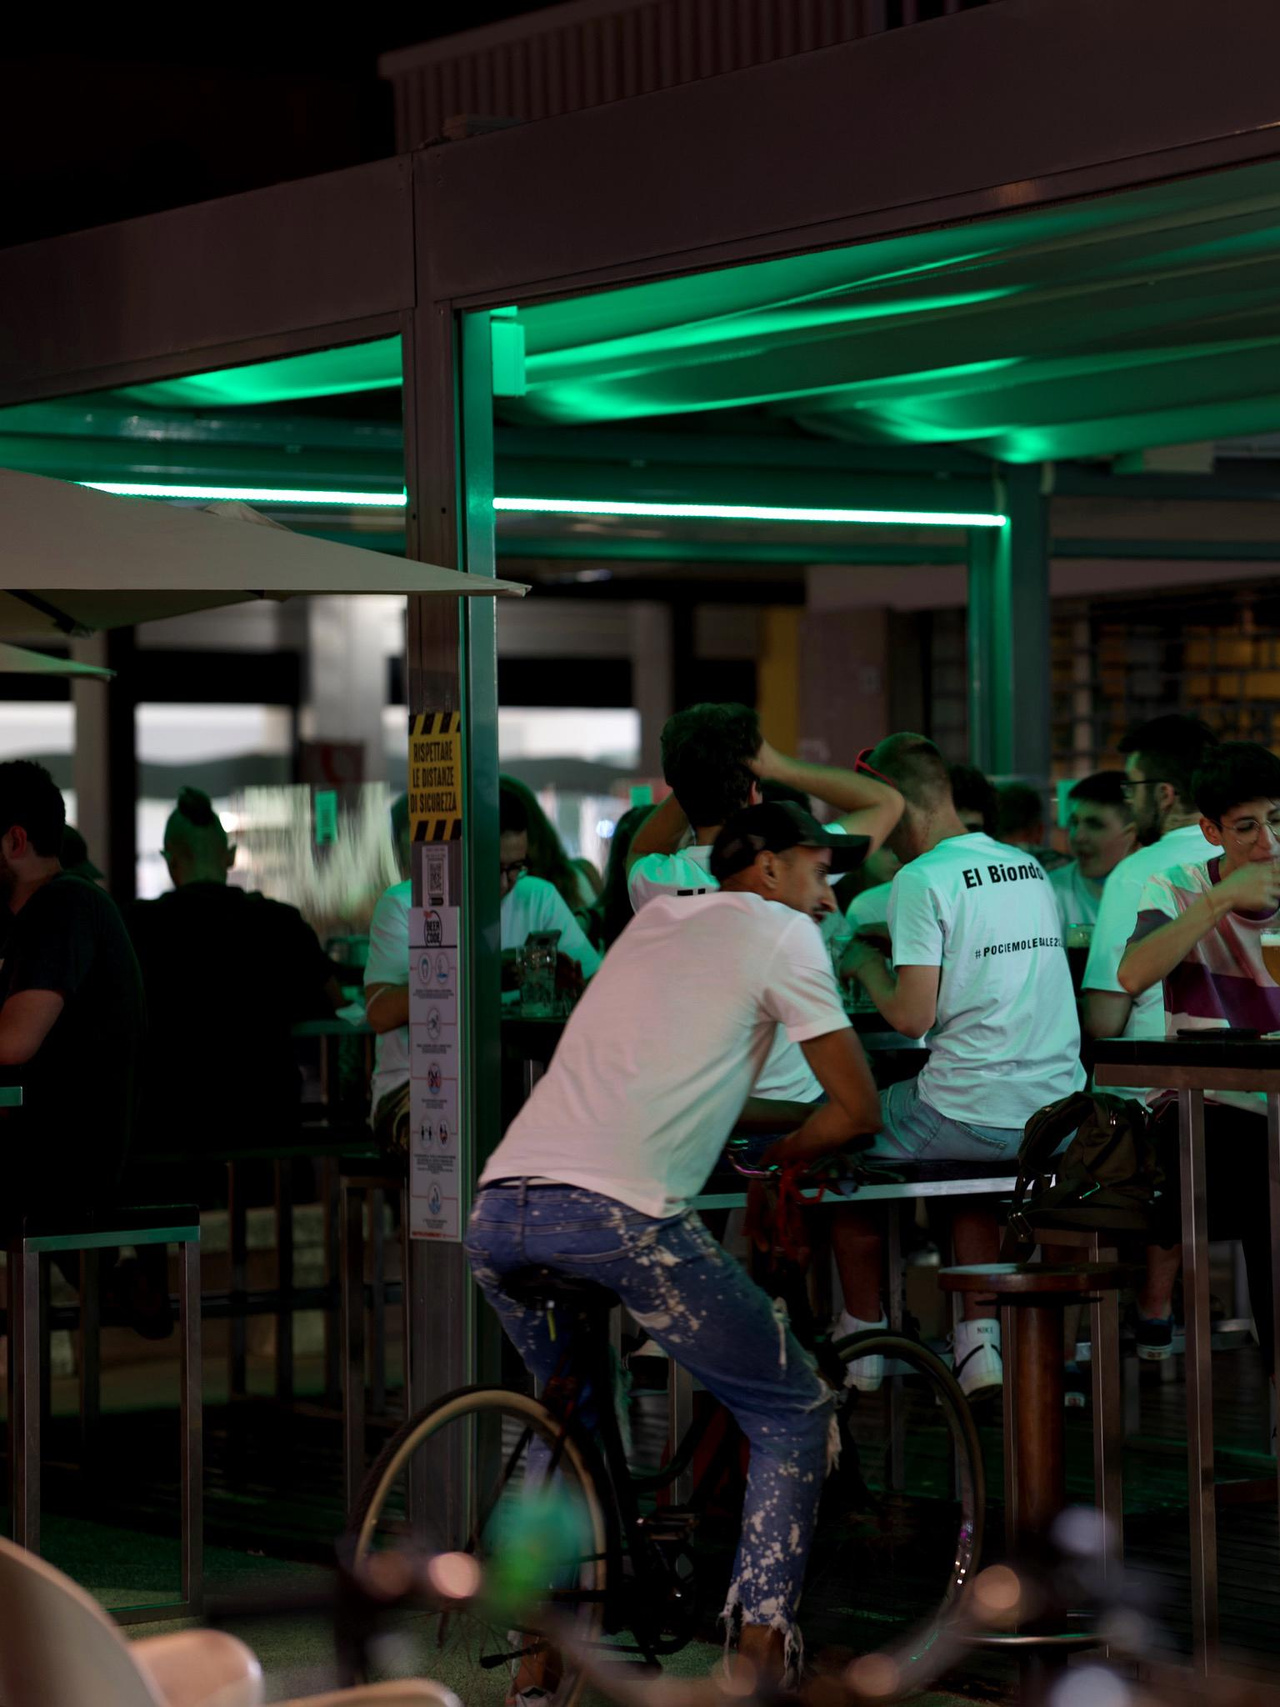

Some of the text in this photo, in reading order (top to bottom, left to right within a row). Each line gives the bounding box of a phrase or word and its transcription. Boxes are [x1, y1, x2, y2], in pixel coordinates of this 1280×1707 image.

[413, 741, 453, 762] RISPETTARE
[412, 766, 454, 788] LE DISTANZE
[410, 792, 457, 813] DI SICUREZZA
[962, 862, 1044, 889] El Biondo
[426, 932, 440, 944] CODE
[975, 937, 1064, 960] #POCIEMOLEBALE2
